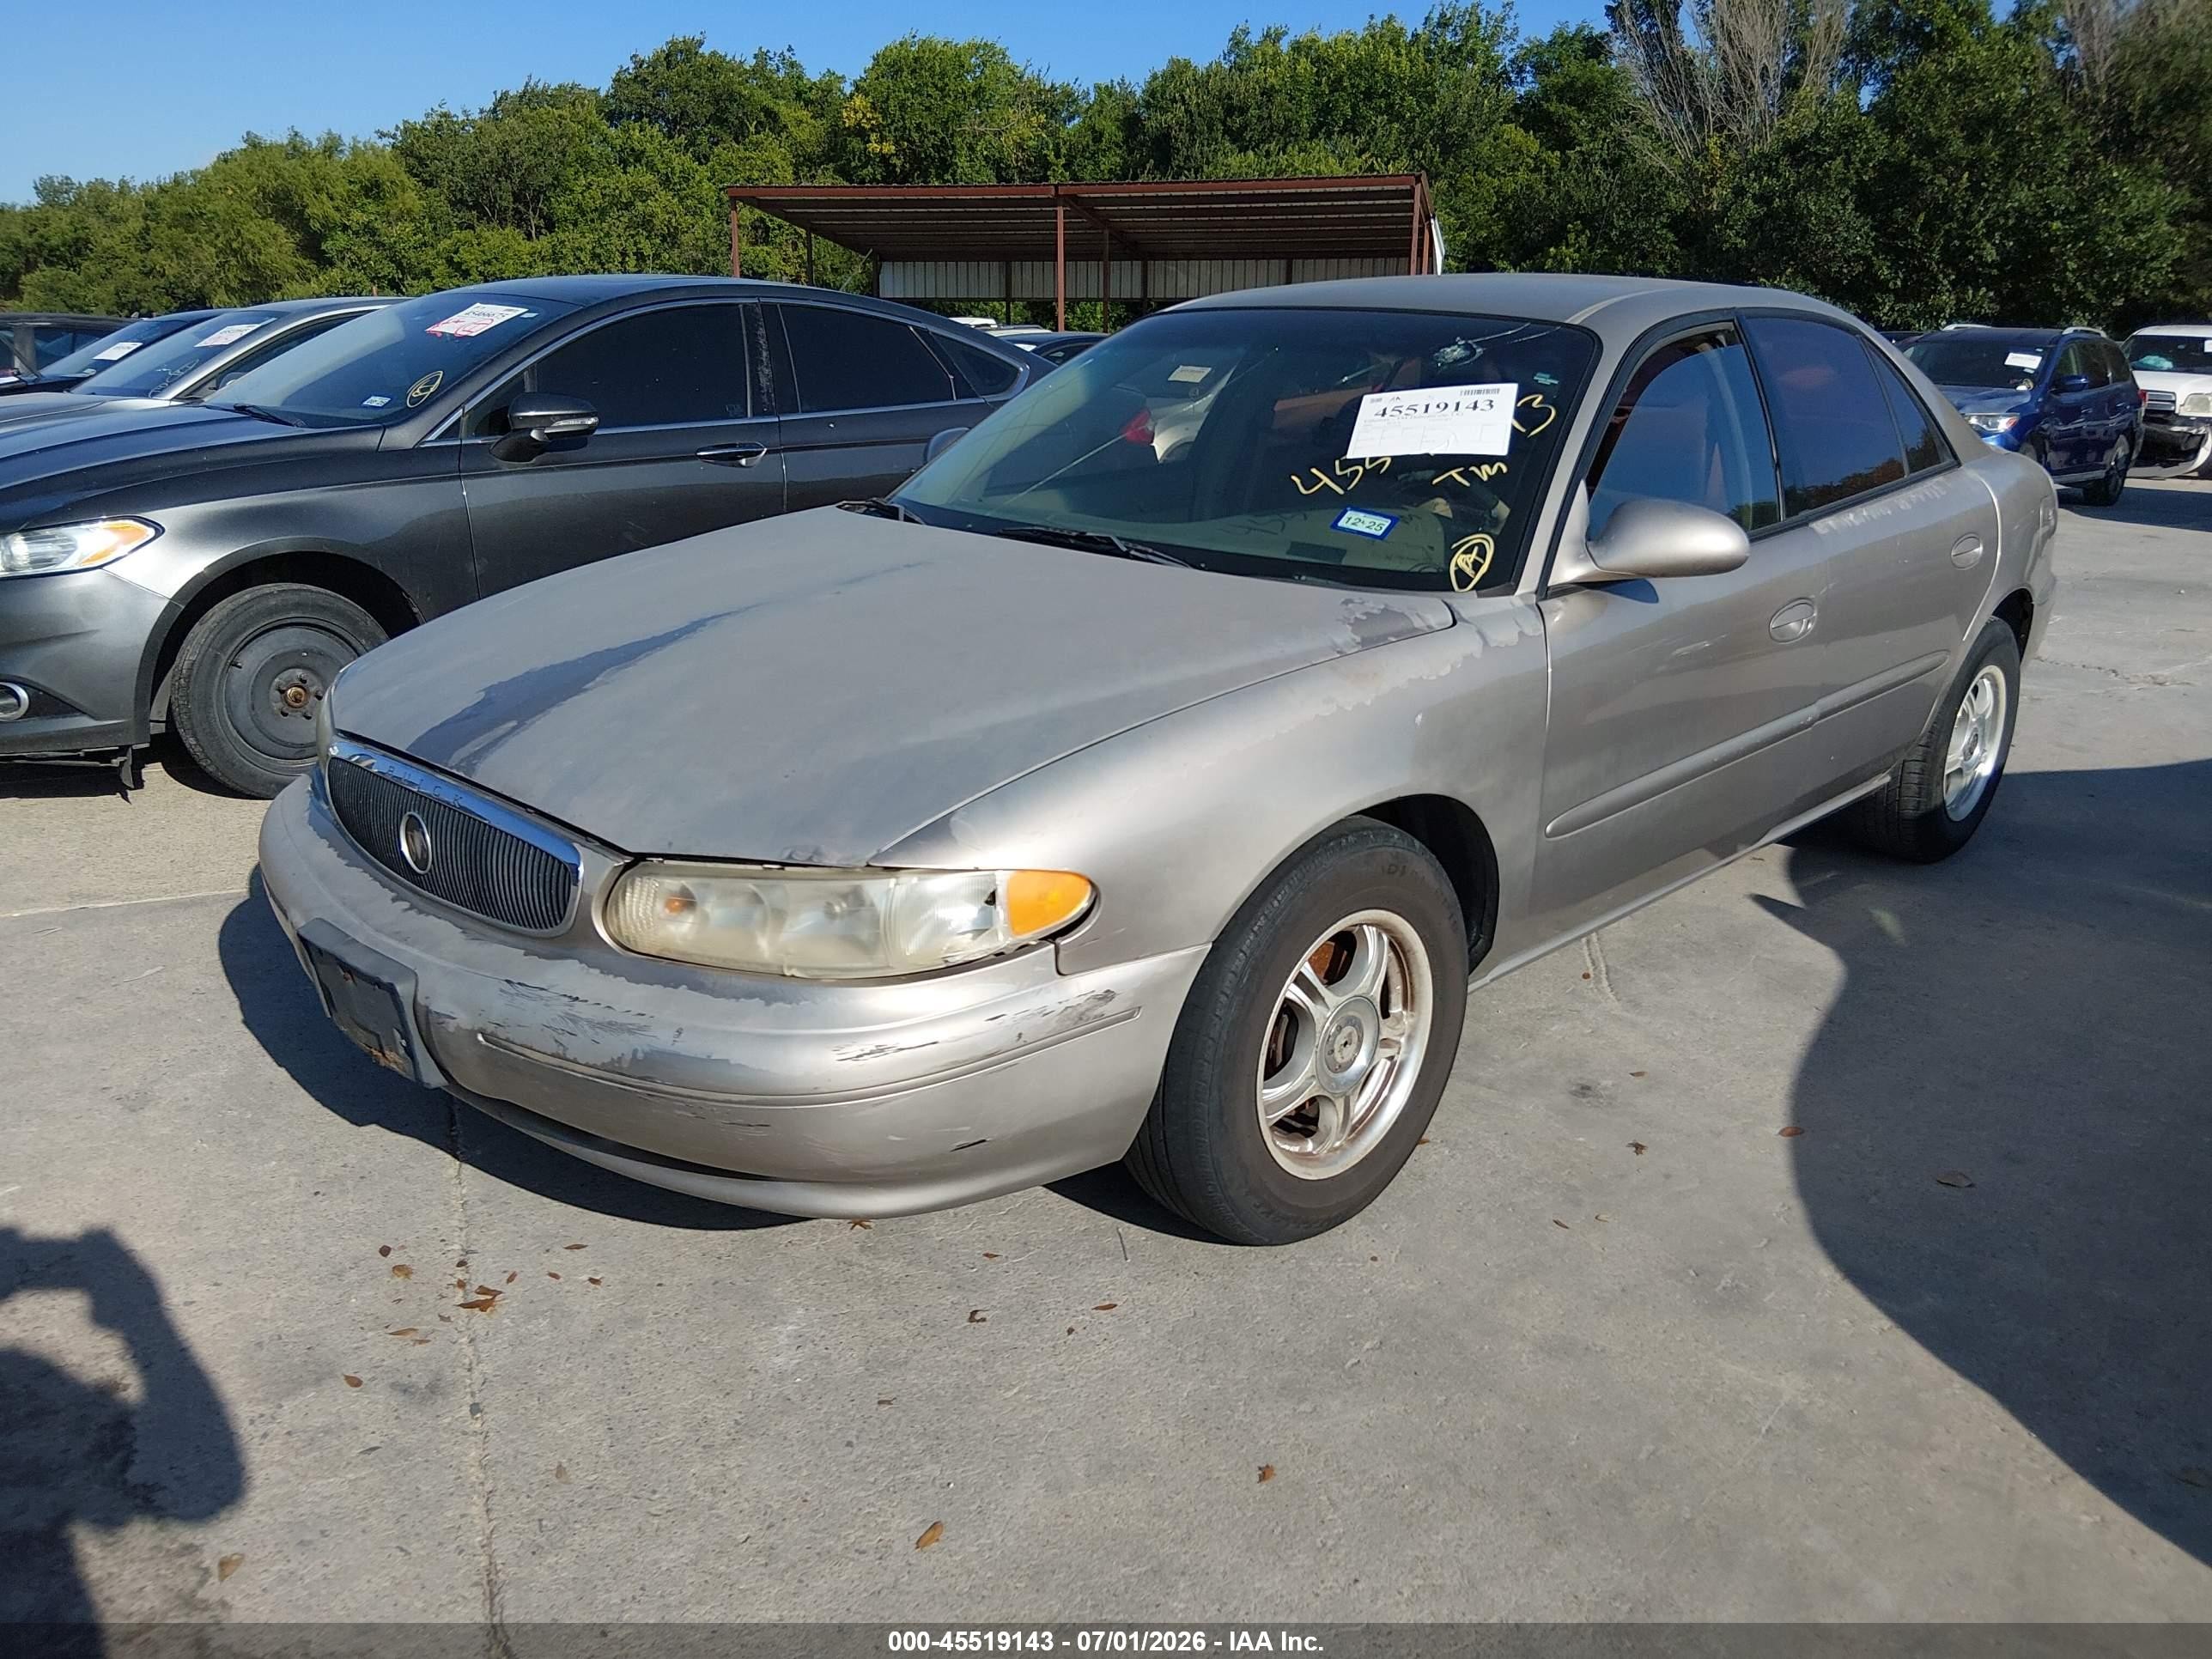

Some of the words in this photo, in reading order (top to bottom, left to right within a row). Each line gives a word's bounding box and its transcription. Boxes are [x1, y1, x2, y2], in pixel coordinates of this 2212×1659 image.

[1374, 398, 1495, 417] 45519143
[1511, 394, 1557, 438] 3
[387, 764, 464, 808] BUICK
